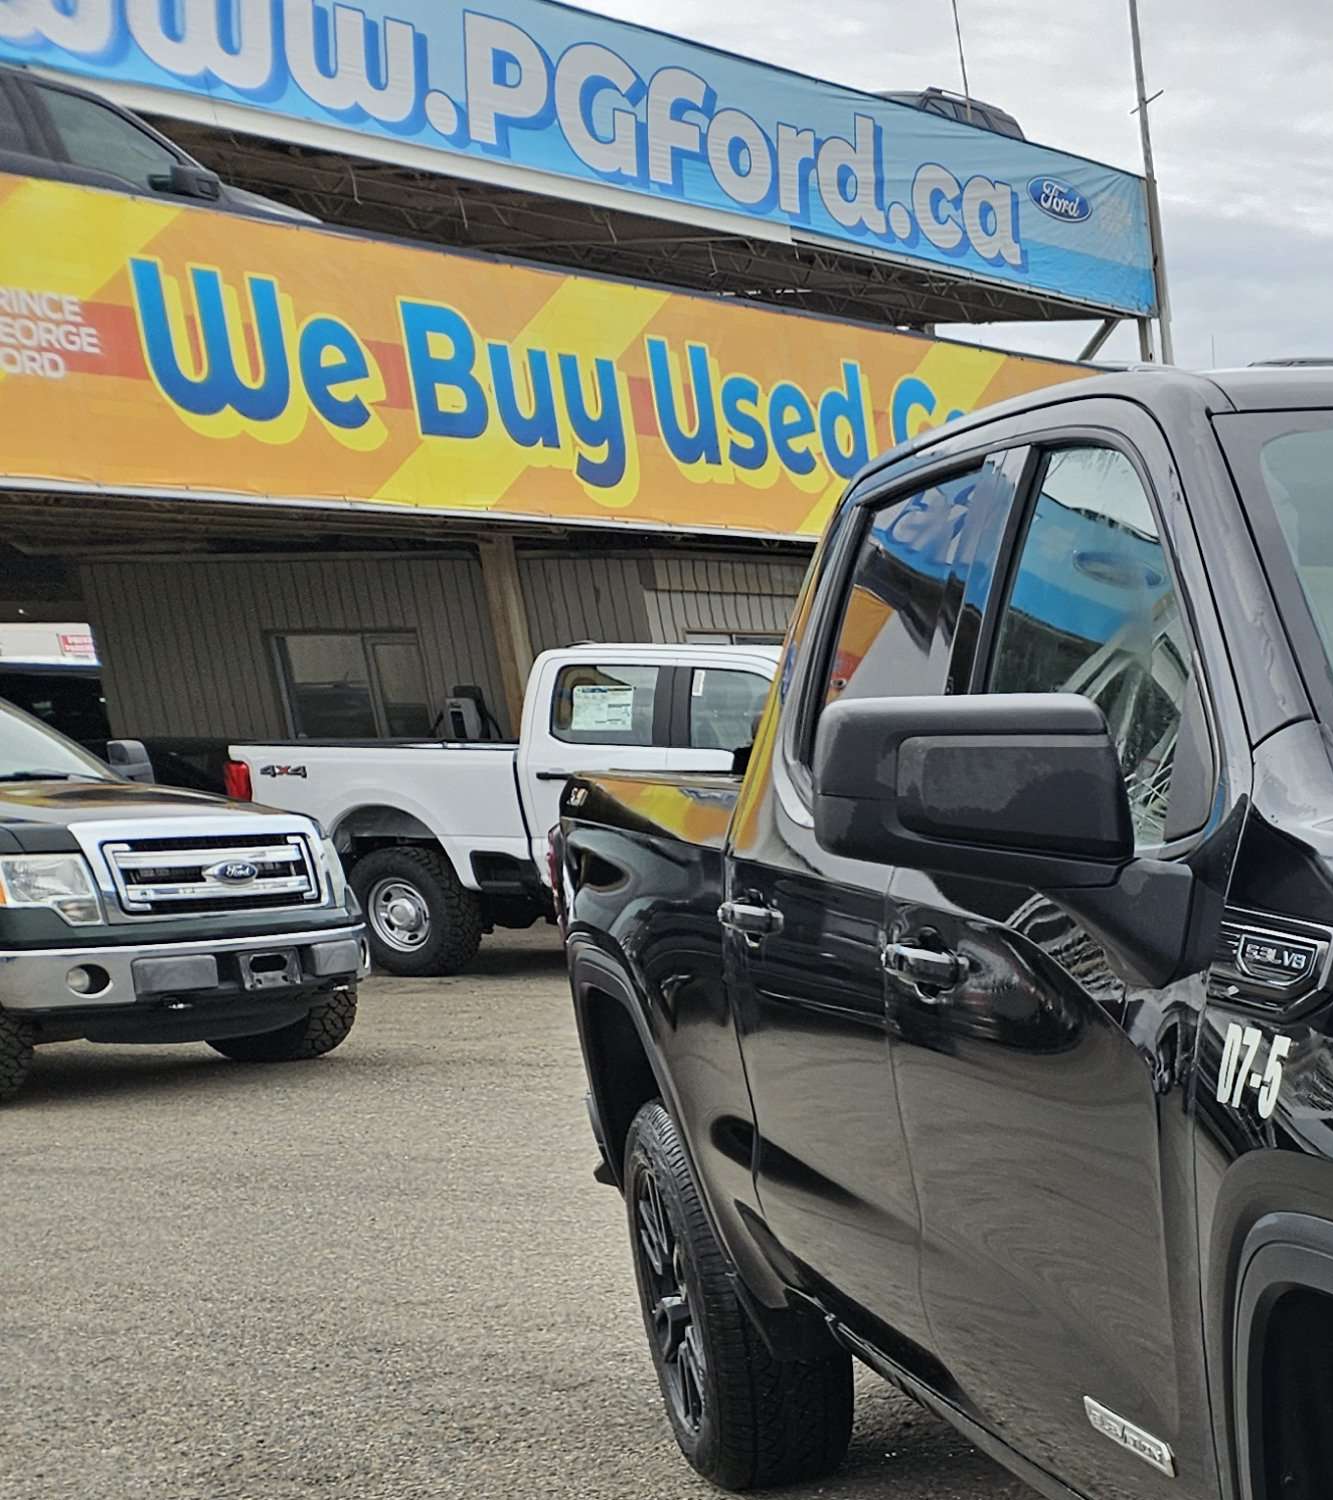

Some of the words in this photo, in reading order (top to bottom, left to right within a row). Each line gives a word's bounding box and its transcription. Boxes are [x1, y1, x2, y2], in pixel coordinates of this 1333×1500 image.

[1041, 181, 1080, 217] Ford
[130, 257, 373, 430] We
[399, 299, 626, 489] Buy
[645, 338, 870, 481] Used
[1282, 950, 1307, 970] V8
